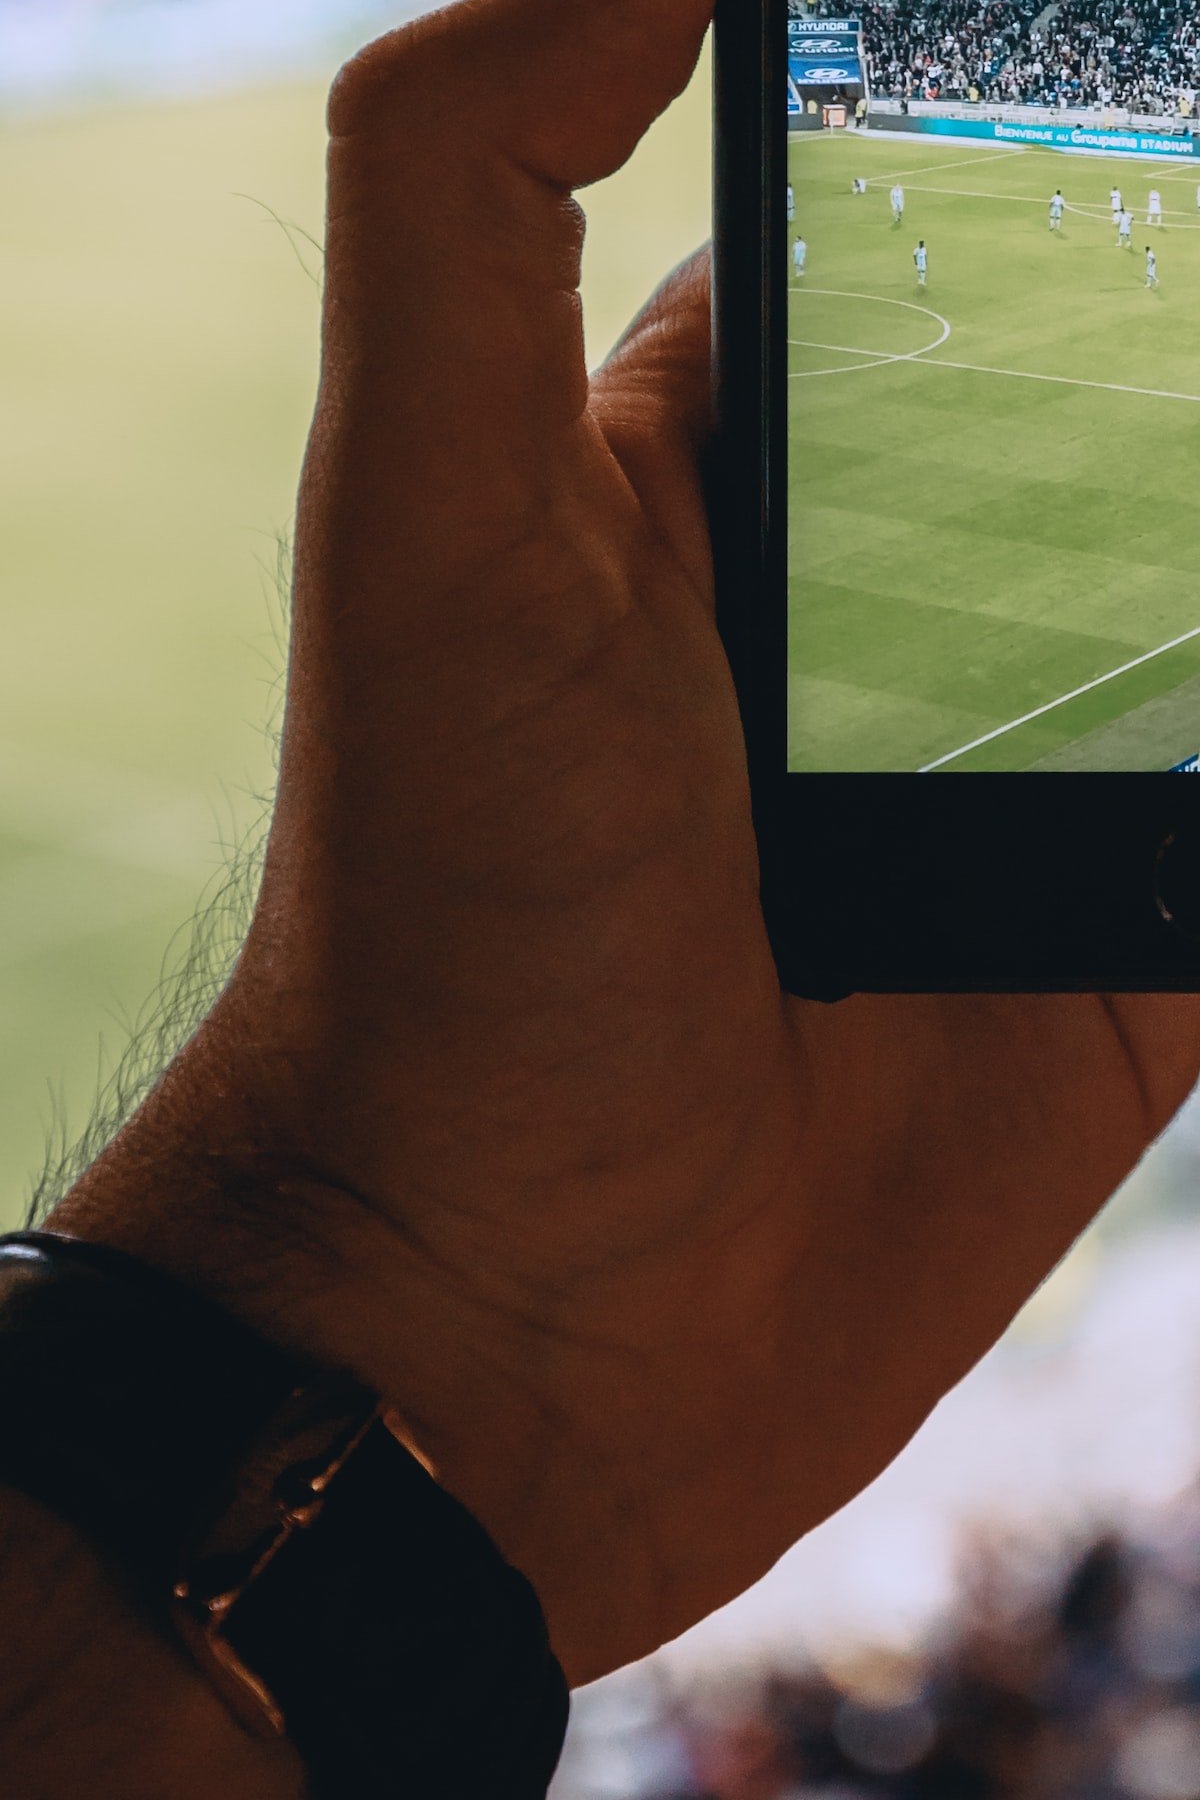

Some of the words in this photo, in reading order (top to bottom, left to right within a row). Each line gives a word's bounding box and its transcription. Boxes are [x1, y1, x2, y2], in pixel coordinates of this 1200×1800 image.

[798, 21, 849, 31] HYUNDAI
[995, 125, 1053, 141] BIENVENUE
[1056, 133, 1069, 143] AU
[1071, 128, 1138, 150] Groupama
[1140, 137, 1193, 153] STADIUM
